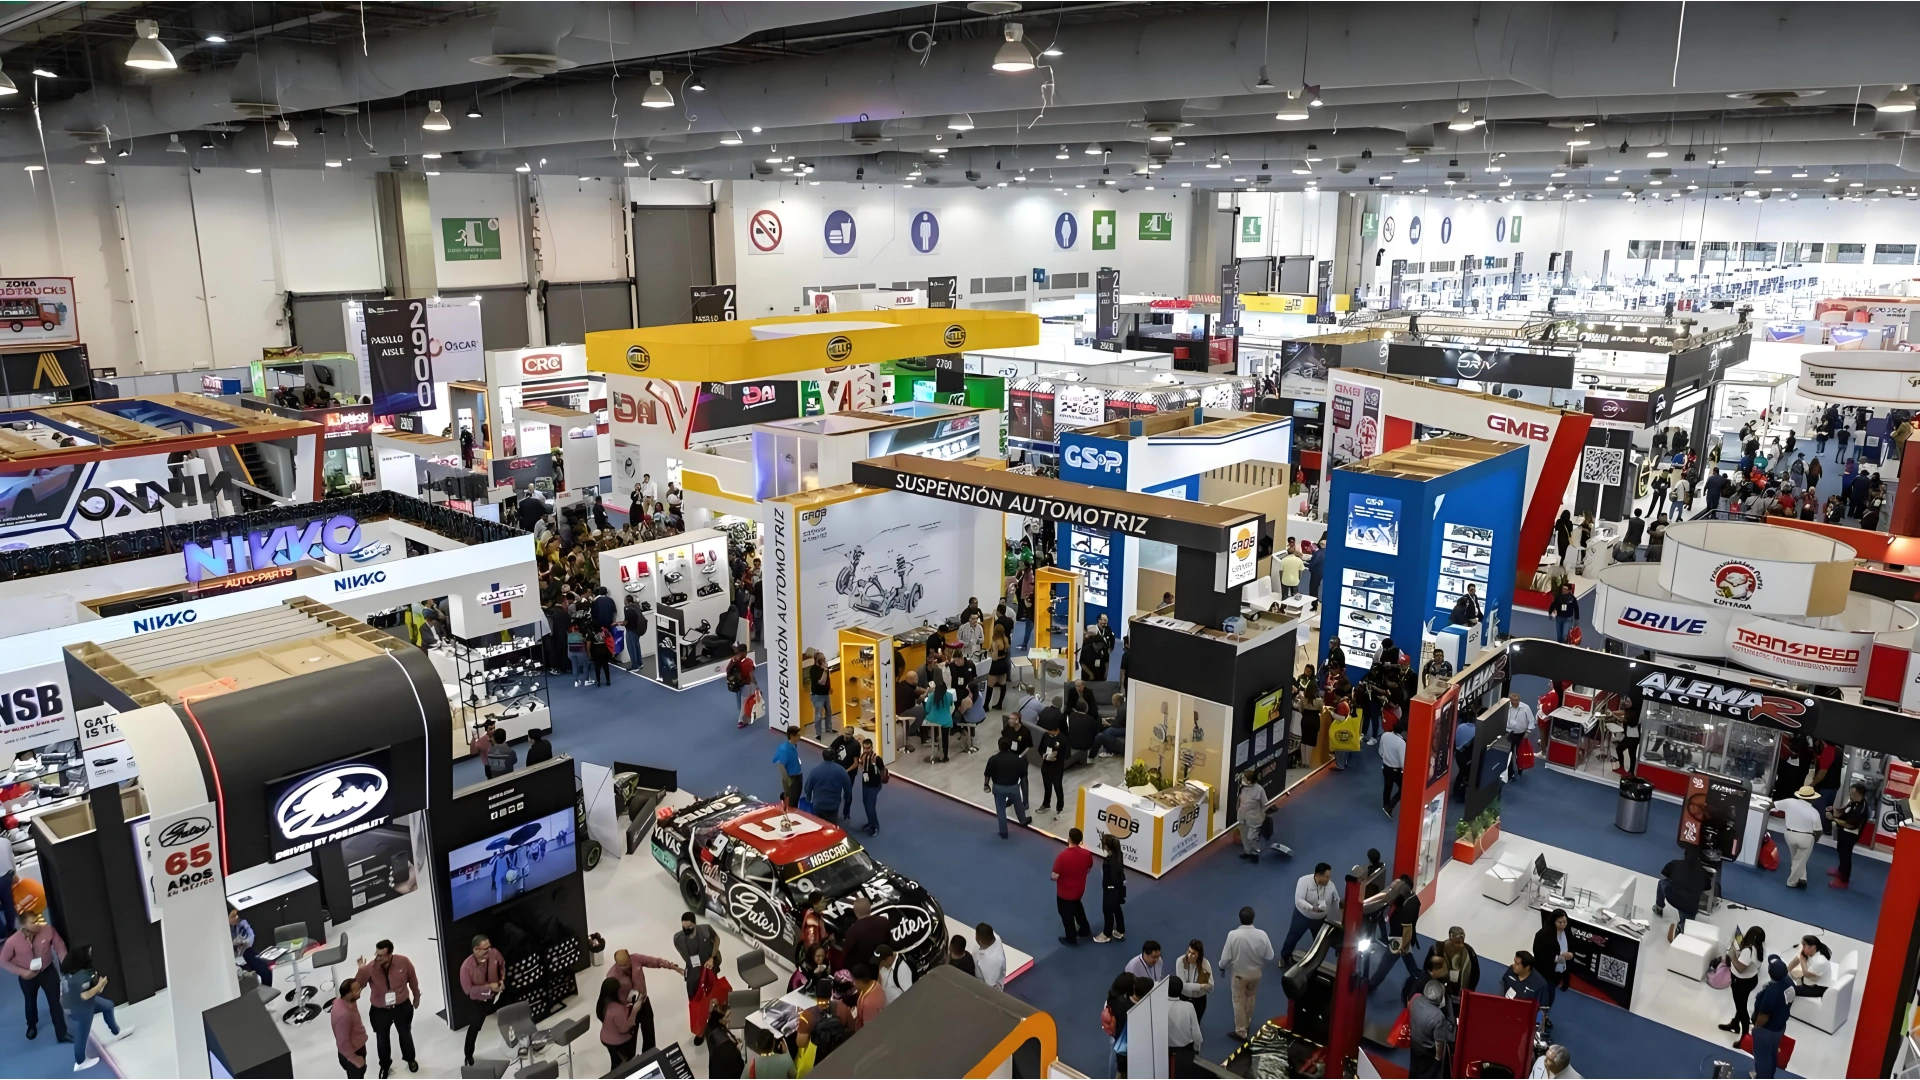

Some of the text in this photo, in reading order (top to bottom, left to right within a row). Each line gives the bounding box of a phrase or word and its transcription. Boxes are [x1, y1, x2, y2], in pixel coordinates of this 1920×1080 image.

[371, 335, 404, 345] PASILLO
[382, 347, 405, 356] AISLE
[409, 302, 431, 407] 2900
[524, 358, 561, 372] CRC
[1487, 414, 1550, 441] GMB
[896, 474, 1149, 535] SUSPENSIÓN AUTOMOTRIZ
[184, 515, 362, 583] NIKKO
[225, 568, 294, 588] AUTO-PARTS
[334, 570, 386, 592] NIKKO
[134, 609, 197, 634] NIKKO
[775, 508, 790, 727] SUSPENSIÓN AUTOMOTRIZ
[1622, 607, 1707, 634] DRIVE
[1737, 628, 1859, 663] TRANSPEED
[1642, 687, 1742, 716] RACING
[86, 728, 99, 738] IS
[1097, 809, 1140, 833] GROB
[1172, 807, 1200, 833] GROB
[165, 842, 213, 876] 65
[810, 844, 848, 867] NASCAR
[731, 888, 777, 936] Gates
[886, 915, 928, 941] ates
